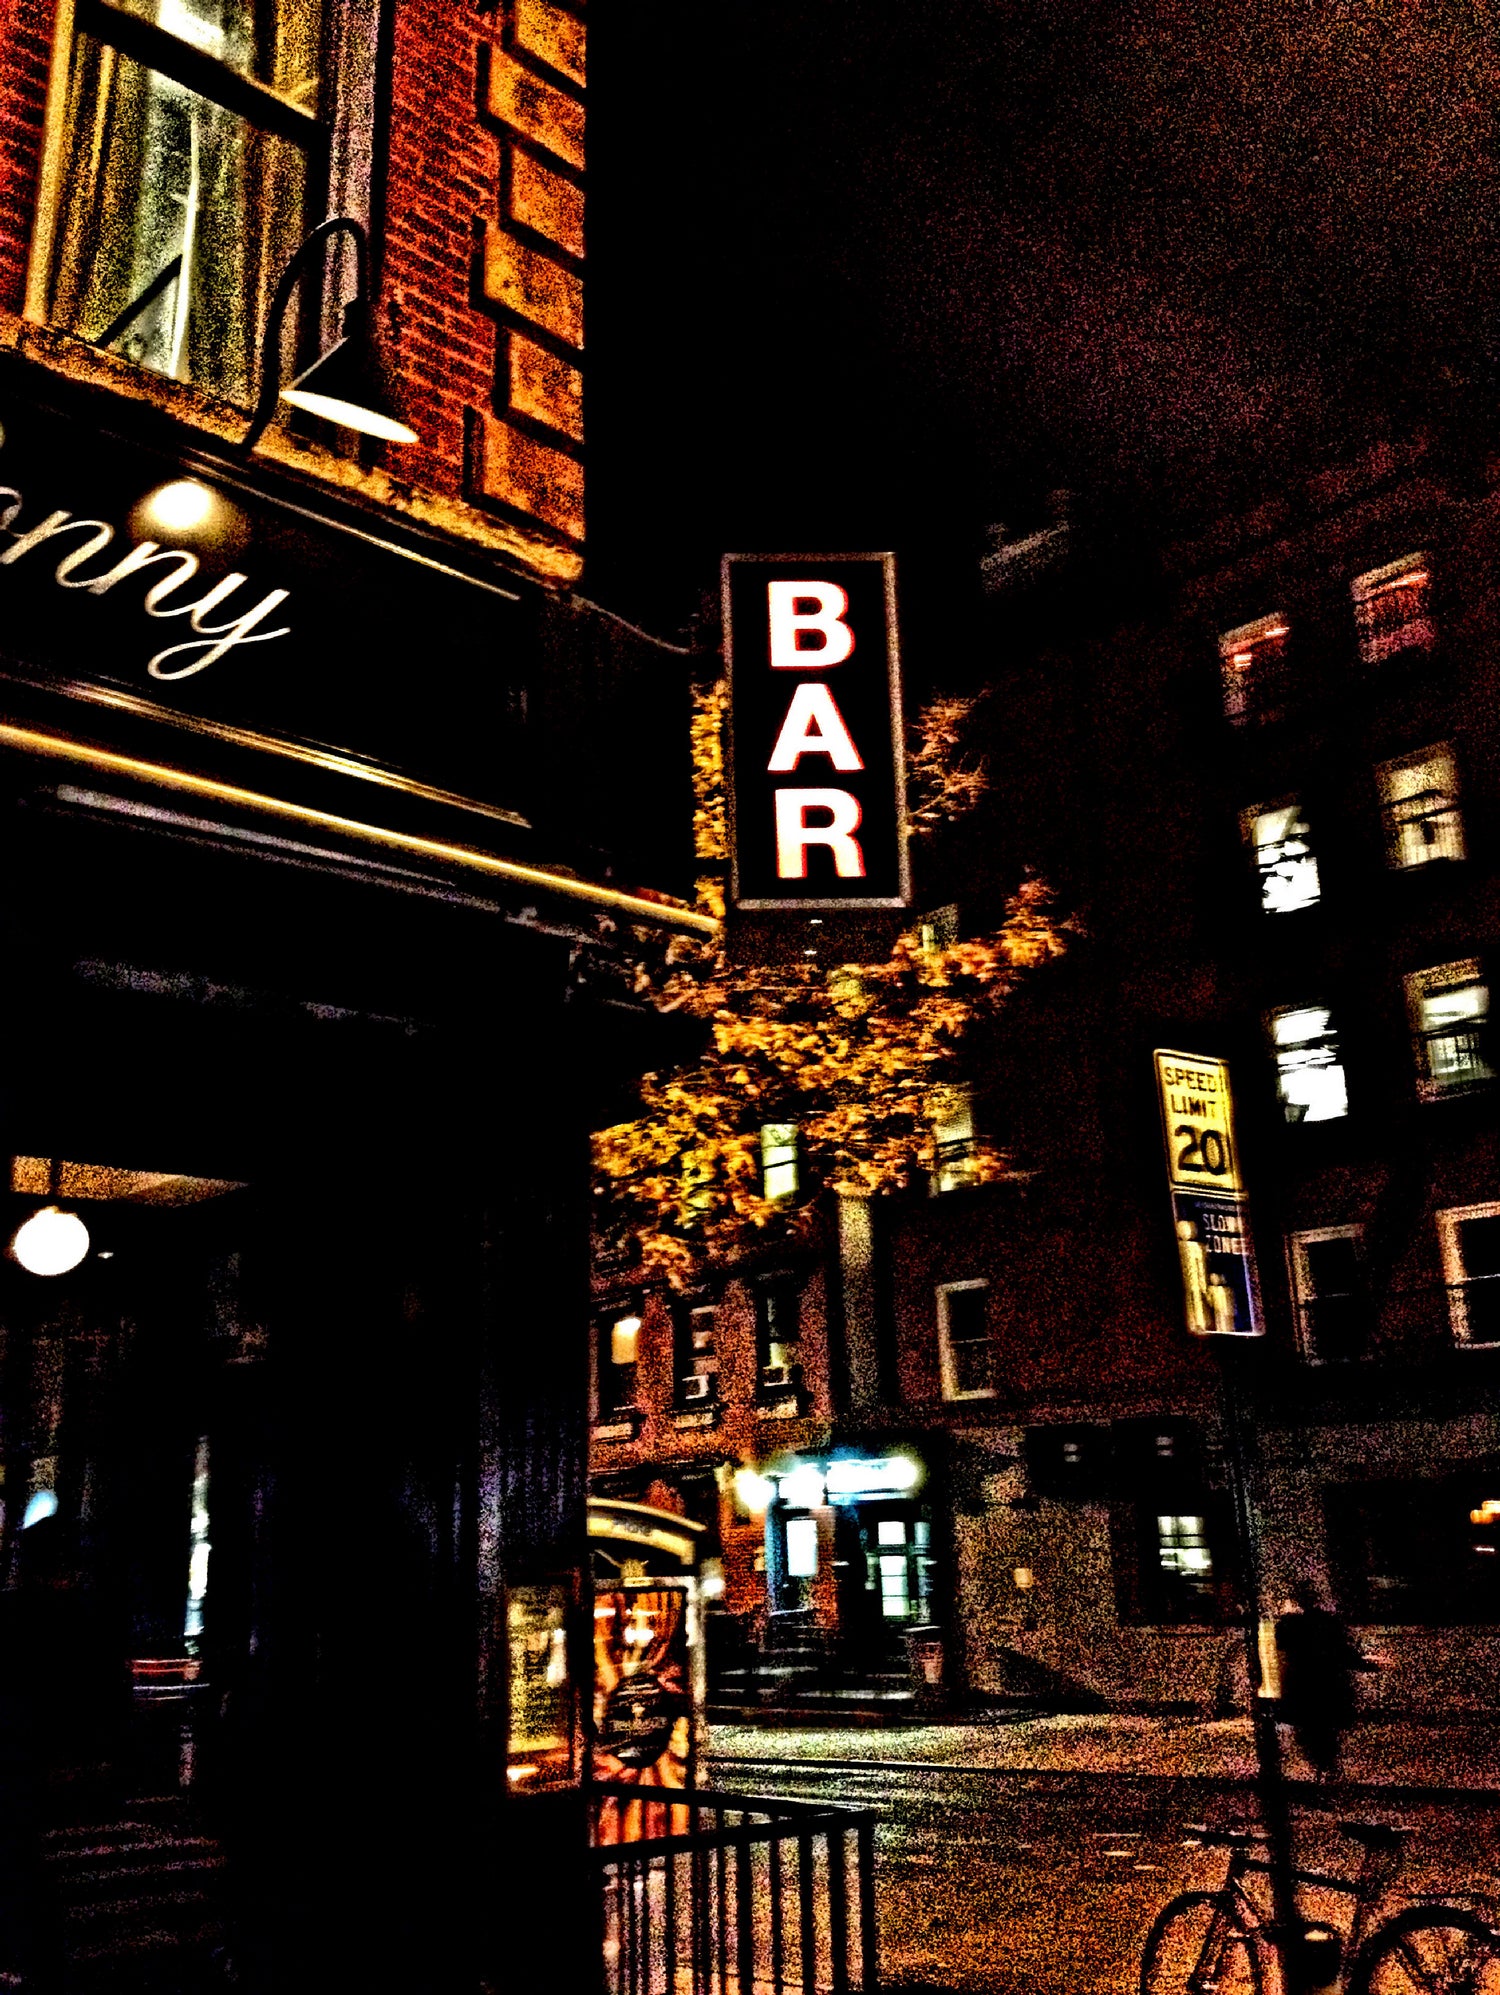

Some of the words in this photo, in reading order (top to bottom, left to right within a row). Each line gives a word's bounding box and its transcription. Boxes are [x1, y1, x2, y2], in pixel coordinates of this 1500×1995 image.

[767, 580, 867, 879] BAR
[1164, 1066, 1219, 1092] SPEED
[1170, 1094, 1217, 1119] LIMIT
[1174, 1124, 1227, 1176] 20
